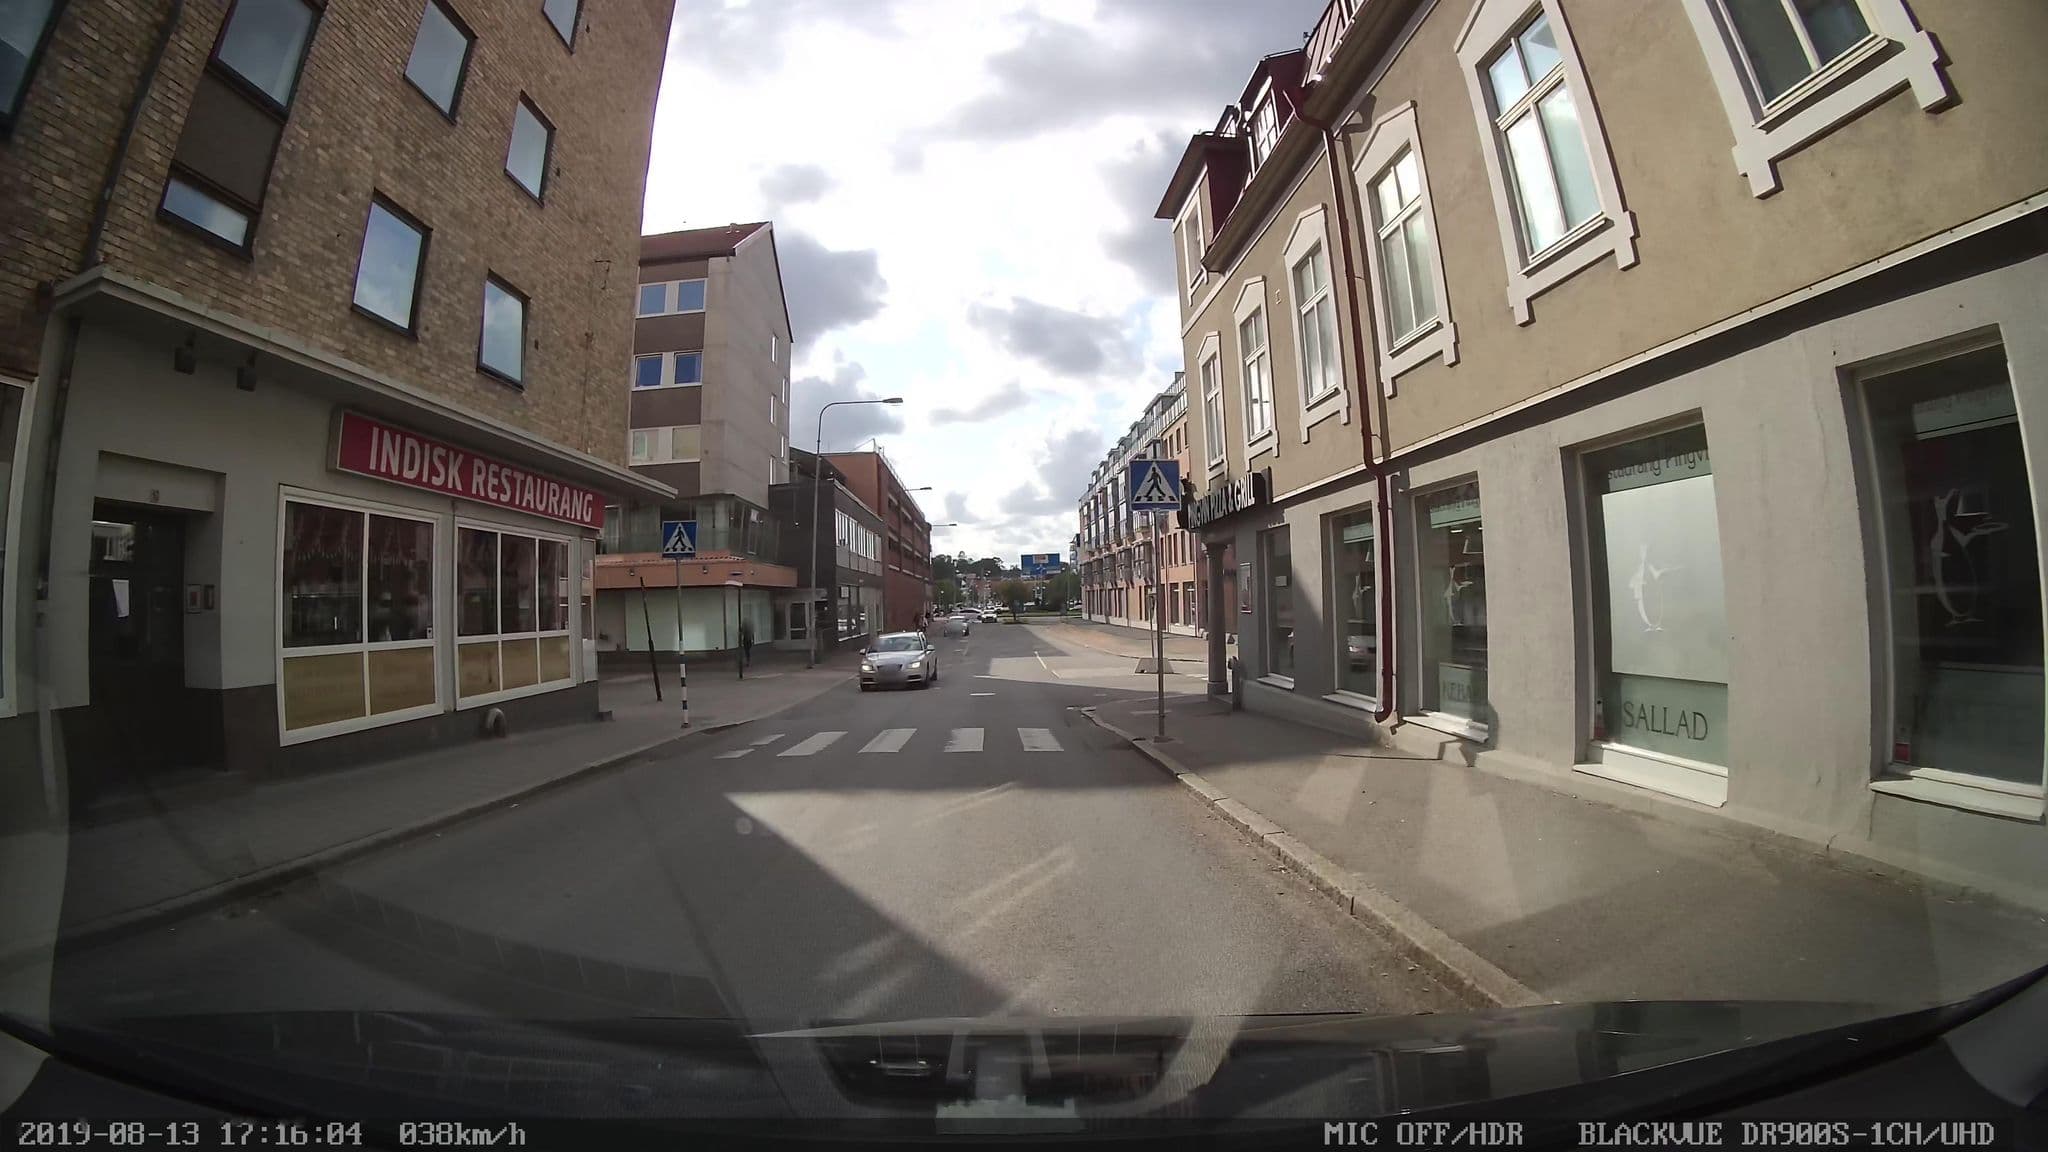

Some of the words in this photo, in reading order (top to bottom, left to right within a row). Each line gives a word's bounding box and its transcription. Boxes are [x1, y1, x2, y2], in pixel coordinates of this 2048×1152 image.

[369, 427, 465, 492] INDISK
[471, 457, 594, 523] RESTAURANG
[1210, 486, 1228, 521] PIZZA
[1234, 471, 1255, 512] GRILL
[1623, 701, 1708, 741] SALLAD
